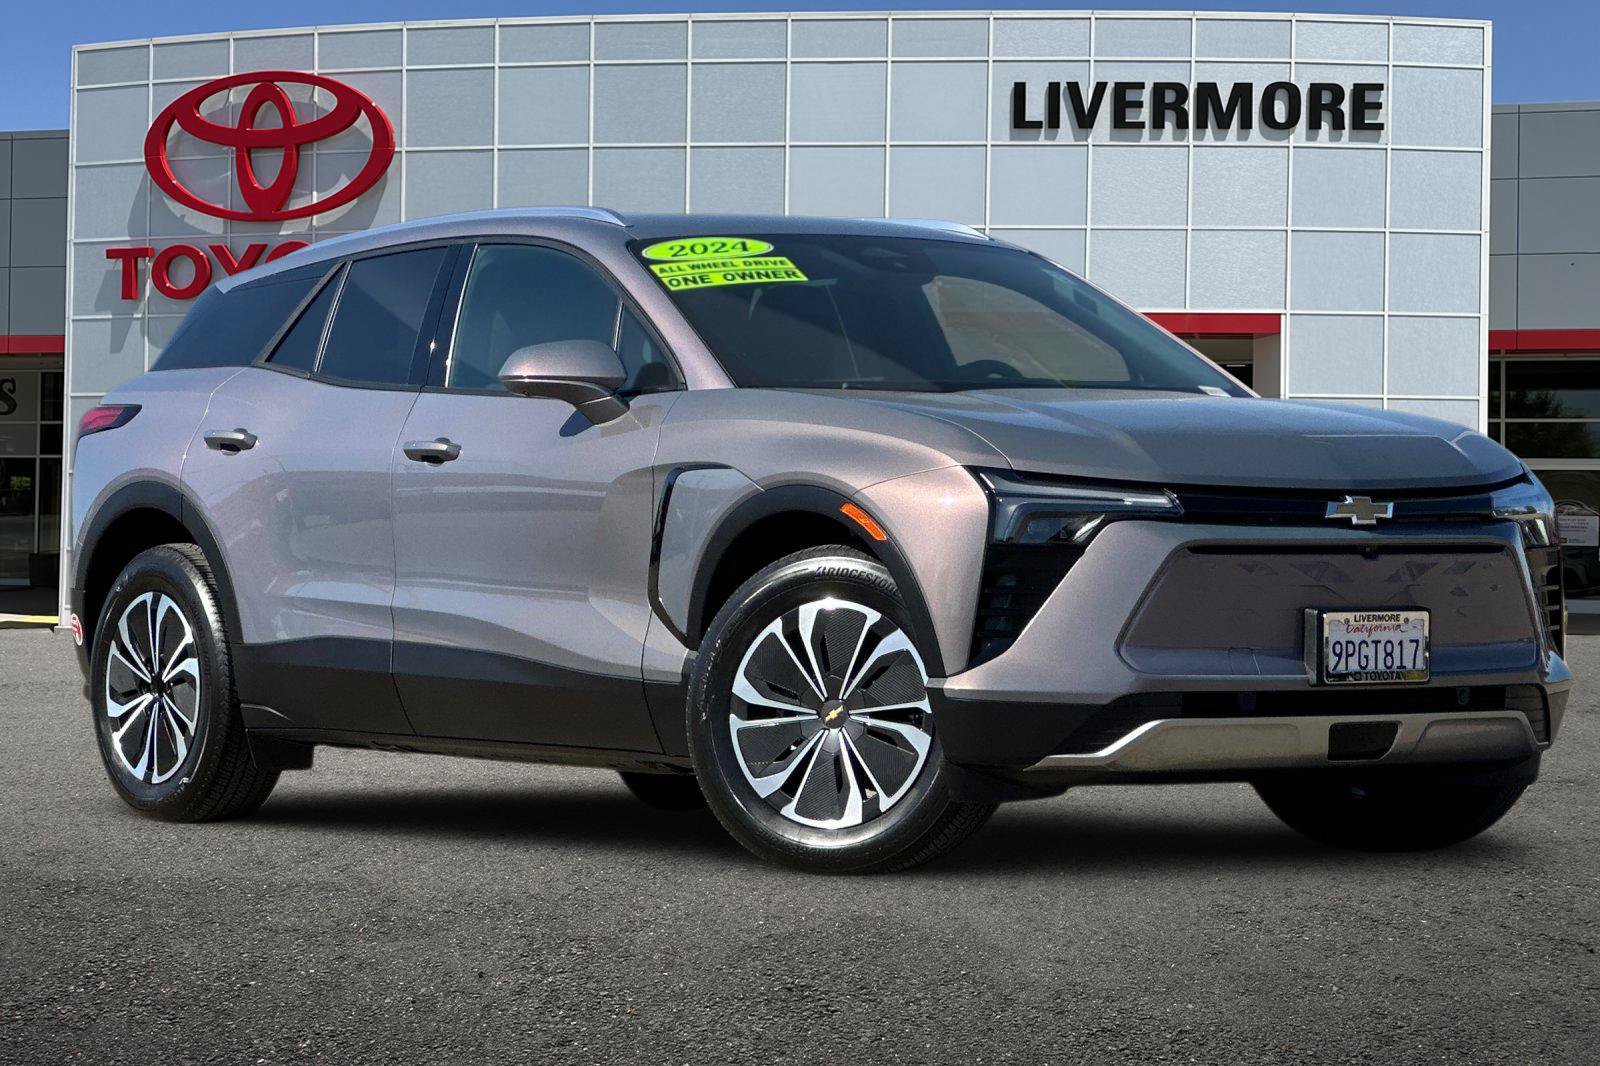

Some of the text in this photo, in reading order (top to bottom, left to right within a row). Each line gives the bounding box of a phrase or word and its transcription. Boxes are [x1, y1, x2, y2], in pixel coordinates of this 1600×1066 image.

[1013, 81, 1385, 131] LIVERMORE
[669, 241, 751, 257] 2024
[106, 241, 312, 300] TOY
[658, 259, 792, 274] ALL WHEEL DRIVE
[668, 269, 801, 288] ONE OWNER
[1353, 613, 1401, 622] LIVERMORE
[1345, 623, 1407, 639] California
[1331, 639, 1420, 671] 9PGT817
[1364, 671, 1402, 680] TOYOTA
